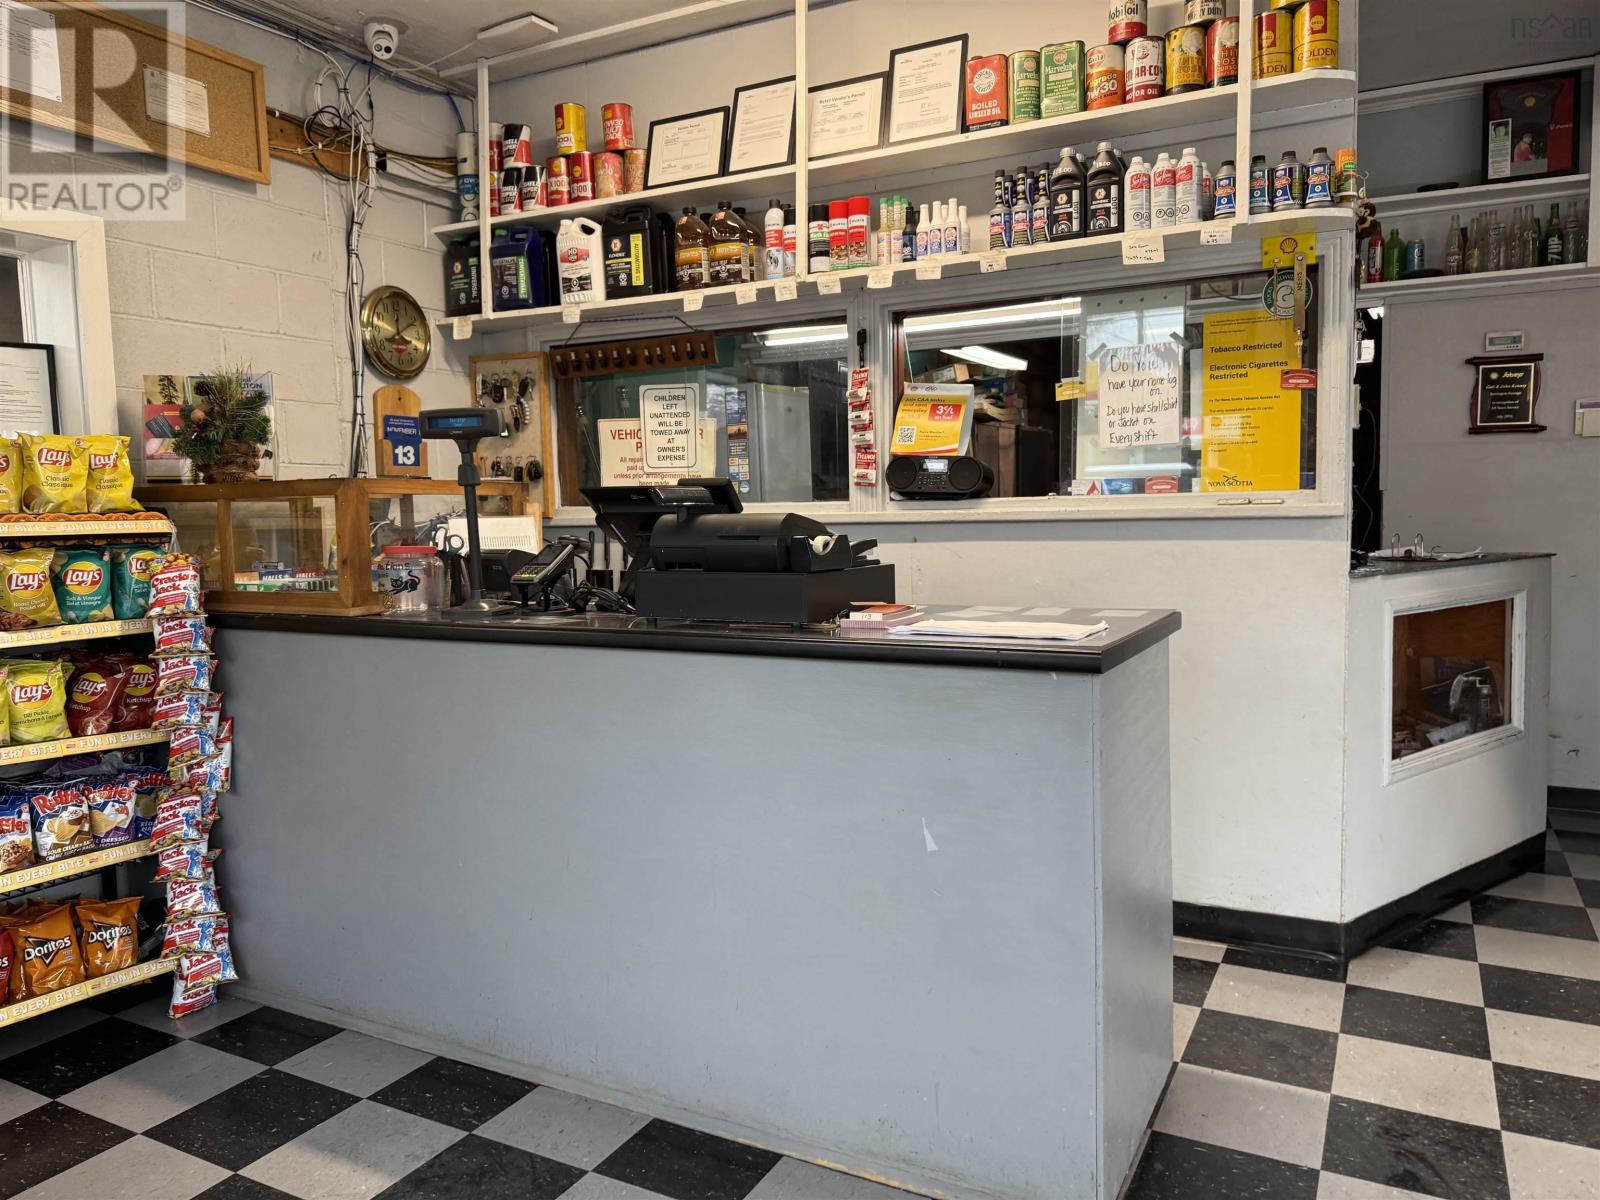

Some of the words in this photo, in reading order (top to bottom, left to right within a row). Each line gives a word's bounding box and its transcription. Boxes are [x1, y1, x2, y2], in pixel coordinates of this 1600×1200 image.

[1207, 7, 1223, 16] DUTY
[972, 100, 998, 111] BOILED
[470, 266, 478, 299] UNIVERSAL
[1210, 345, 1241, 353] Tobacco
[1243, 341, 1282, 350] Restricted
[1209, 363, 1247, 372] Electronic
[1248, 361, 1288, 371] Cigarettes
[1209, 372, 1248, 380] Restricted
[1108, 378, 1126, 391] have
[1129, 377, 1146, 392] your
[653, 394, 686, 402] CHILDREN
[1107, 405, 1116, 416] Do
[1117, 405, 1130, 416] you
[1131, 402, 1147, 415] have
[387, 426, 417, 435] NOVEMBER
[1108, 419, 1116, 428] or
[610, 429, 642, 440] VEHIC
[1109, 433, 1133, 447] Every
[40, 448, 70, 467] Lay's
[394, 445, 416, 466] 13
[646, 472, 687, 480] arrangements
[10, 572, 46, 590] Lay's
[65, 569, 102, 587] Lay's
[152, 573, 198, 588] Cracker
[153, 582, 182, 598] Jack
[24, 631, 52, 641] BITE
[75, 625, 98, 635] FUN
[101, 623, 112, 633] IN
[116, 620, 149, 631] EVERY
[158, 621, 188, 637] Jack
[161, 657, 191, 673] Jack
[14, 684, 51, 703] Lay's
[158, 694, 185, 708] Jack
[34, 710, 50, 718] Pickle
[171, 728, 193, 743] Jack
[29, 745, 57, 756] BITE
[80, 740, 102, 748] FUN
[106, 736, 117, 744] IN
[121, 732, 152, 742] EVERY
[157, 799, 201, 814] Cracker
[0, 818, 28, 834] ffles
[101, 835, 129, 844] DRESSED
[48, 847, 62, 857] SOUR
[62, 843, 78, 853] CREAM
[16, 867, 53, 883] EVERY
[58, 859, 85, 872] BITE
[102, 850, 124, 861] FUN
[127, 847, 137, 856] IN
[171, 884, 199, 902] Jack
[88, 924, 133, 944] Doritos
[168, 920, 196, 936] Jack
[23, 935, 73, 961] Doritos
[13, 998, 50, 1016] EVERY
[55, 987, 82, 1001] BITE
[104, 975, 127, 986] FUN
[129, 970, 141, 980] IN
